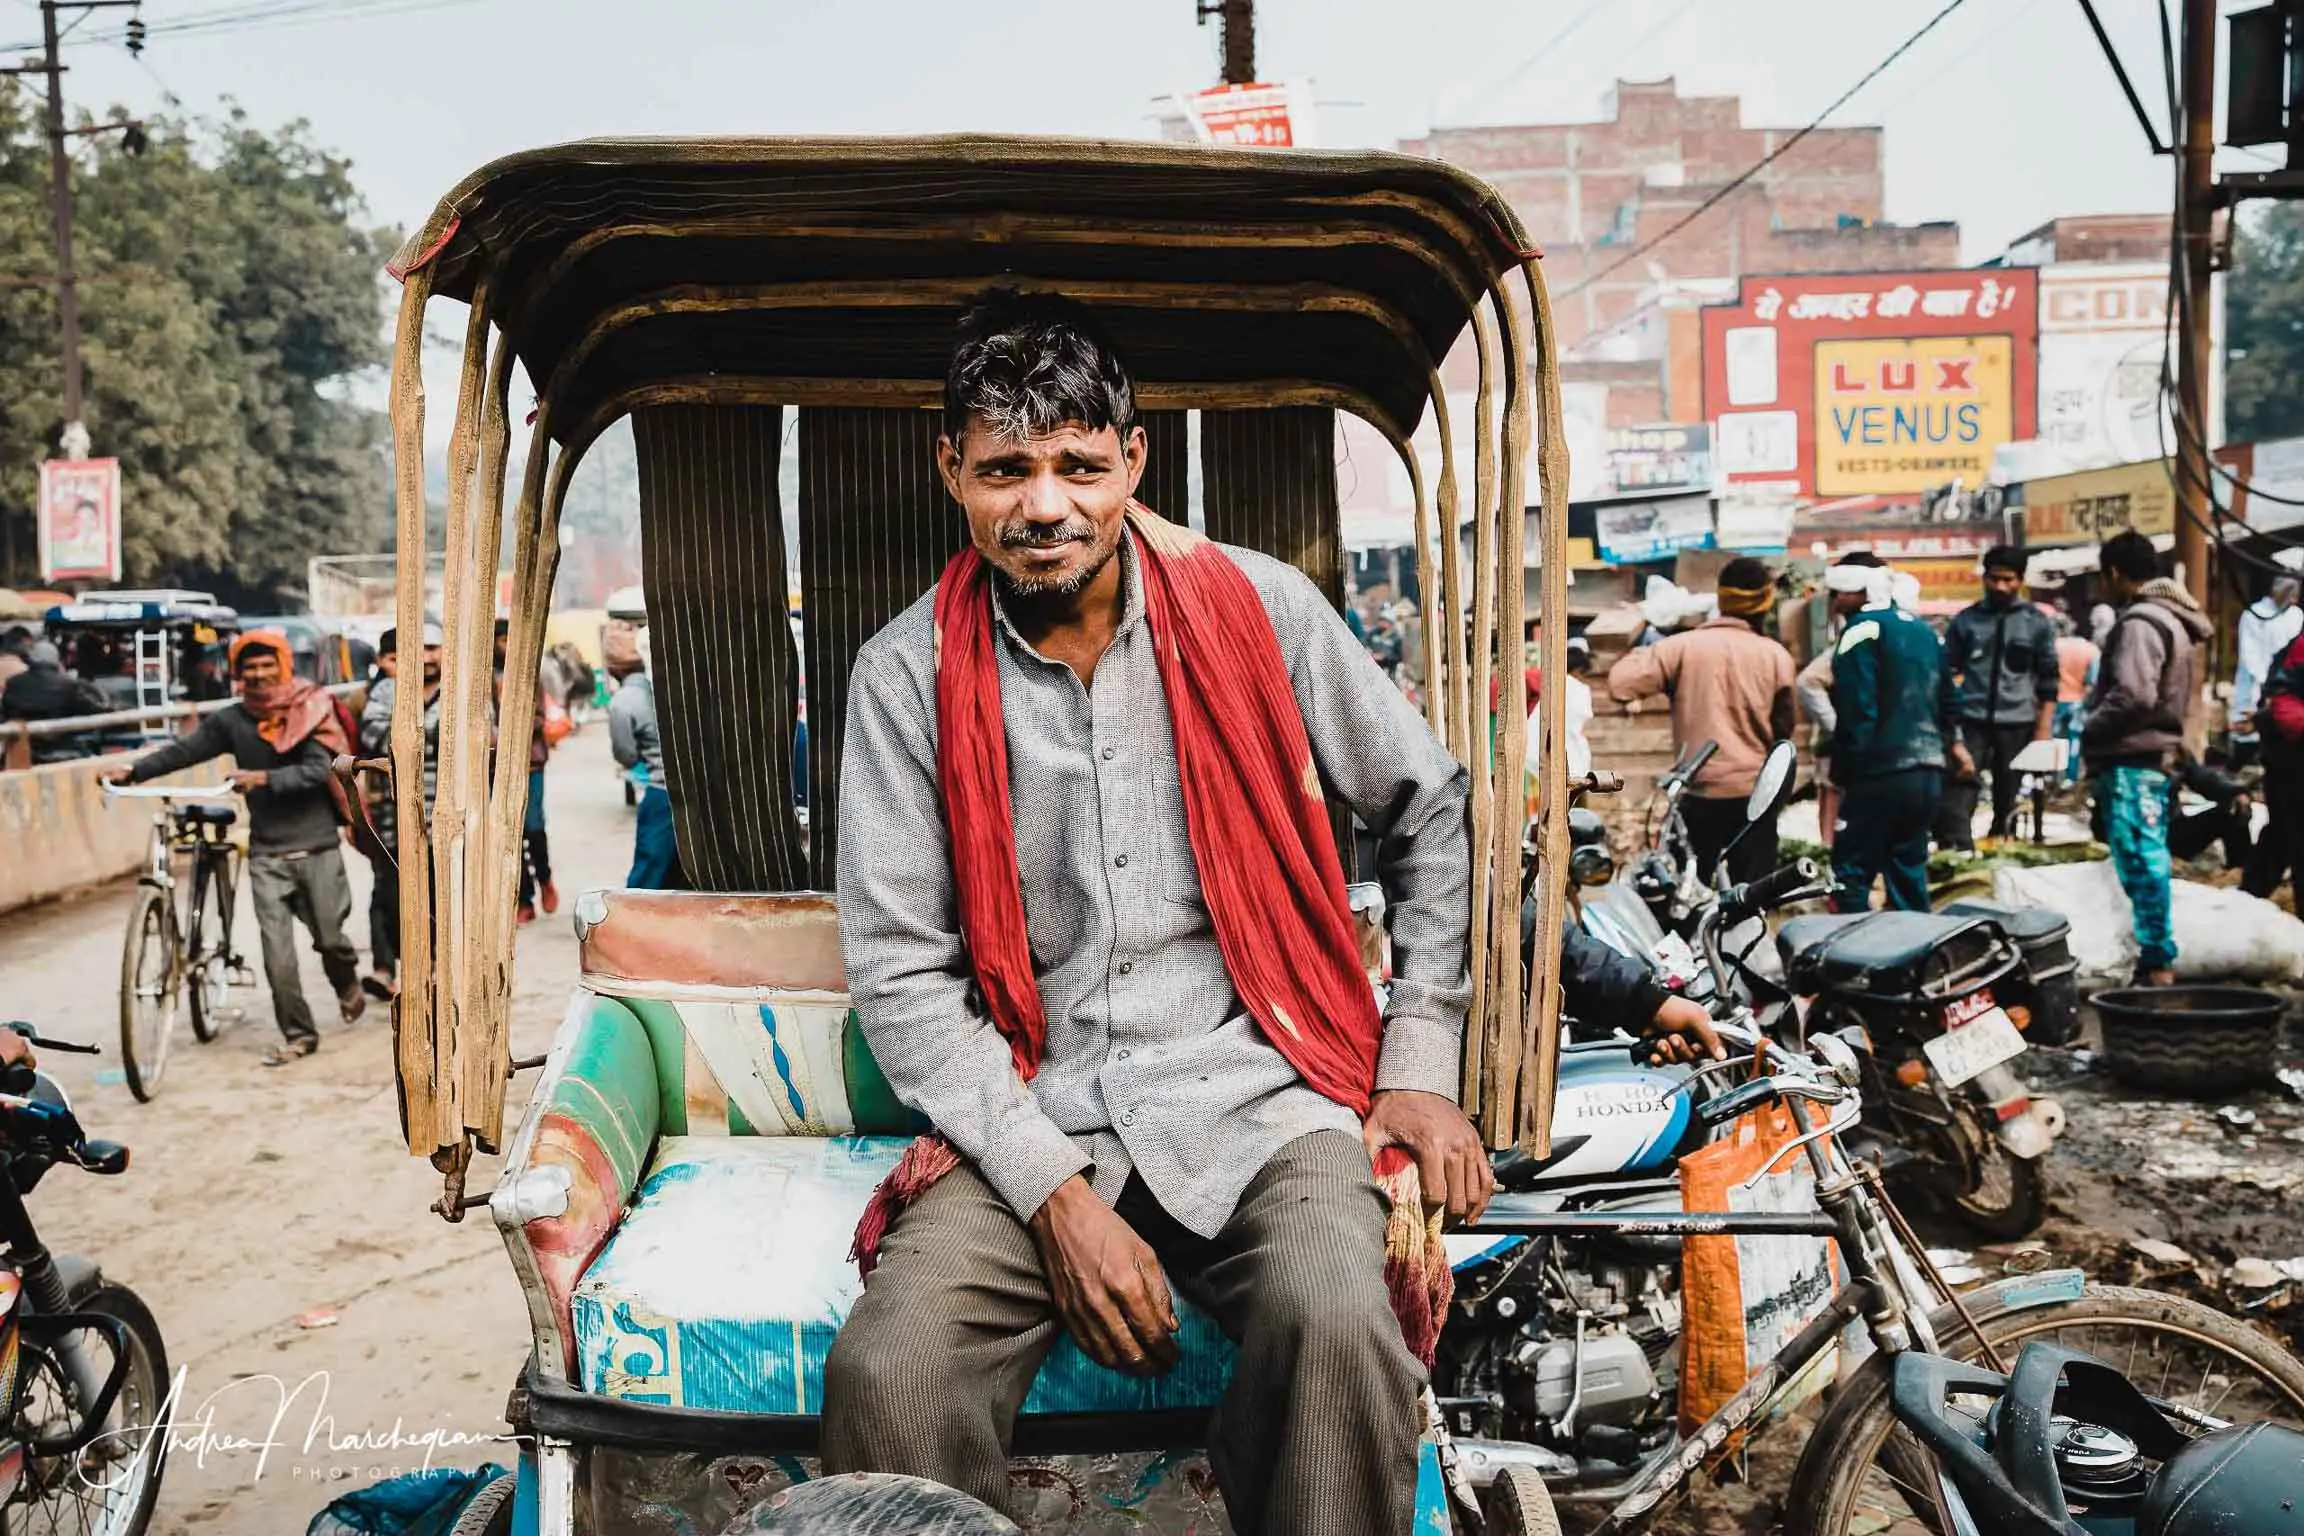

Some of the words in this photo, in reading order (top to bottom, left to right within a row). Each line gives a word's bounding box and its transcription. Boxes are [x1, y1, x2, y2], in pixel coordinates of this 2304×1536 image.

[1834, 361, 1972, 391] LUX
[1832, 404, 1981, 445] VENUS
[1576, 1100, 1670, 1118] HONDA
